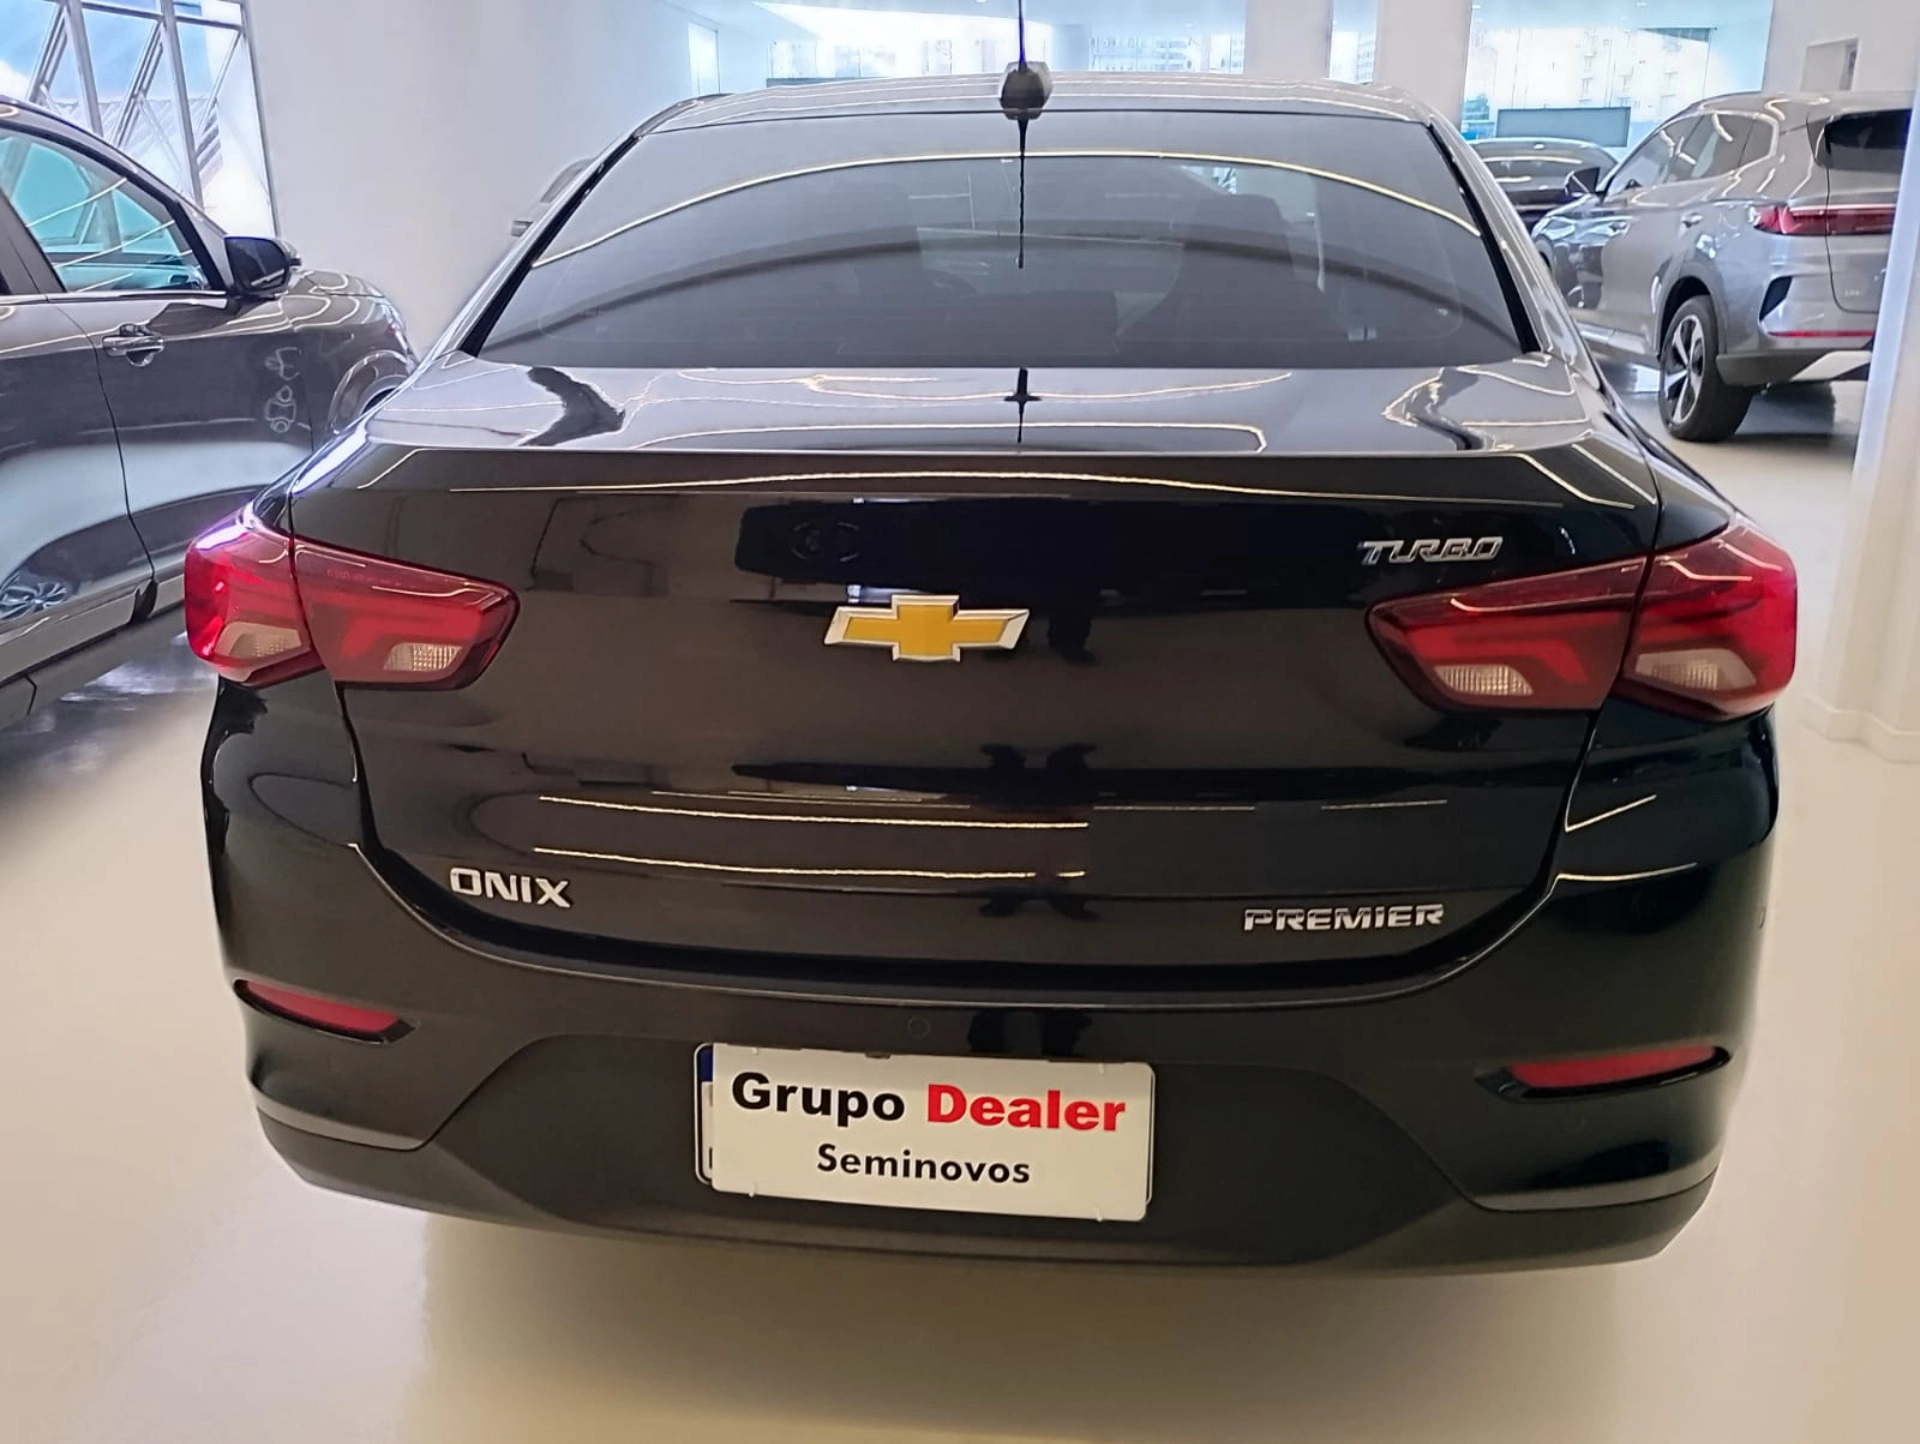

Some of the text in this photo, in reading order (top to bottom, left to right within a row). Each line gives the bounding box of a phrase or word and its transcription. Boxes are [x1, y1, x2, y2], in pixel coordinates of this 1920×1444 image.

[1357, 536, 1504, 566] TURBO
[449, 866, 571, 909] ONIX
[1243, 903, 1445, 931] PREMIER
[731, 1071, 1126, 1132] Grupo Dealer
[816, 1142, 1031, 1184] Seminovos
